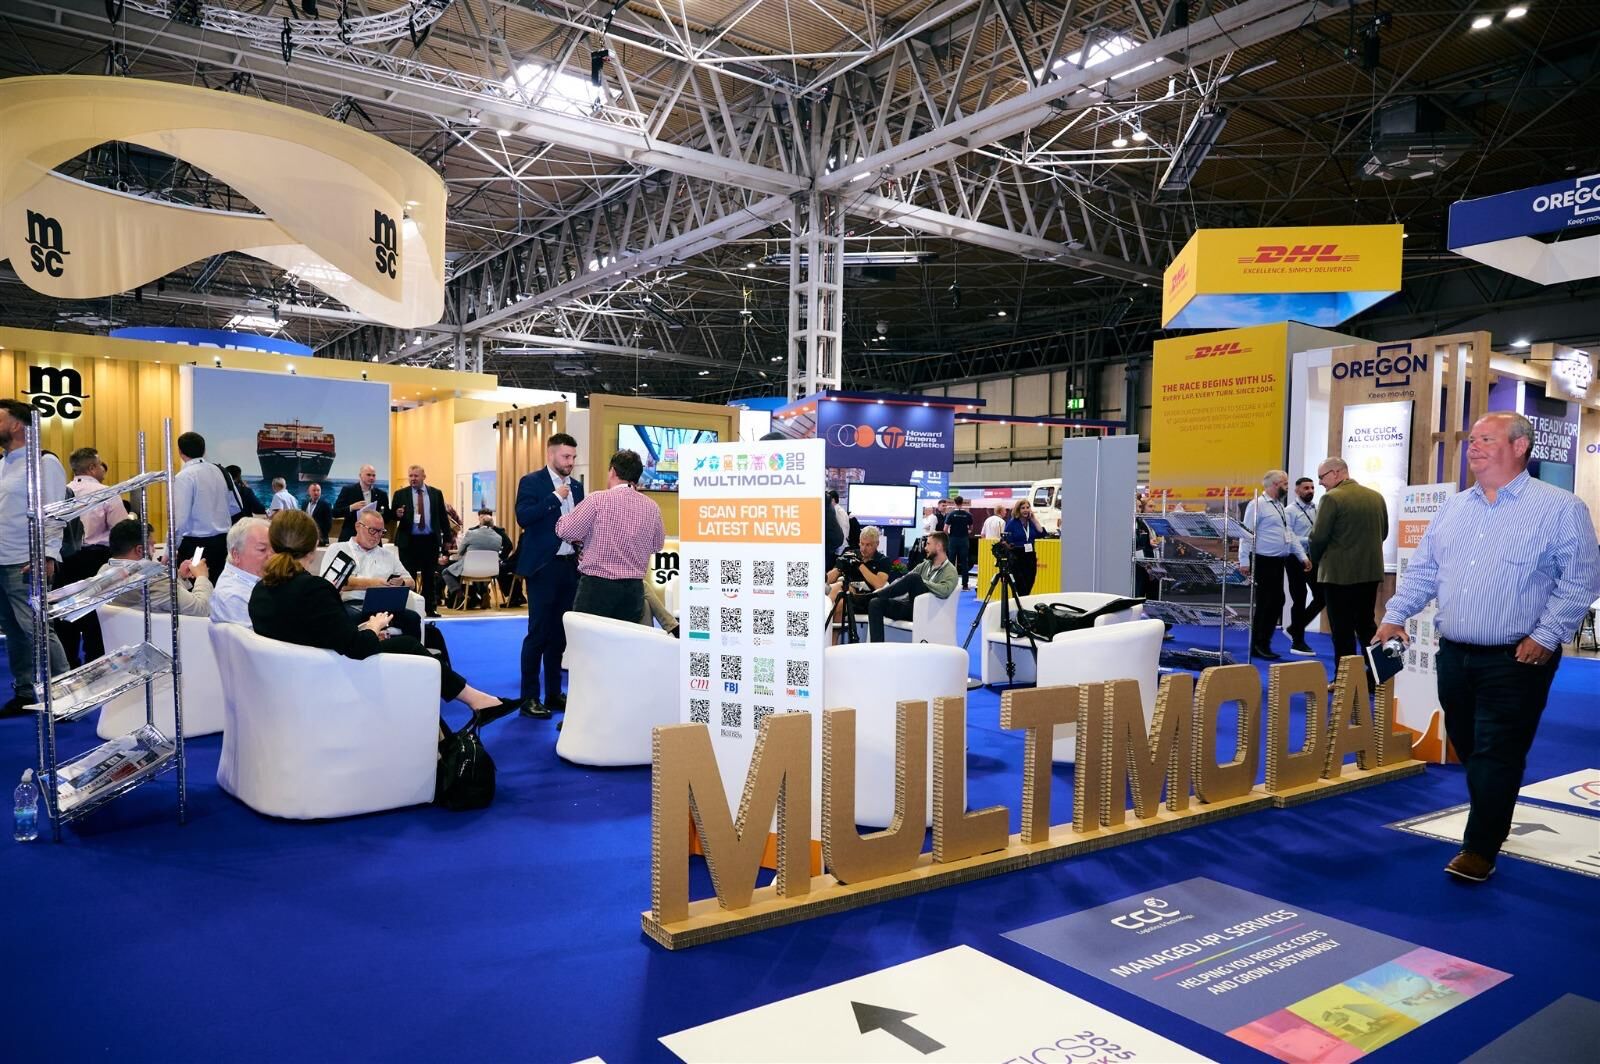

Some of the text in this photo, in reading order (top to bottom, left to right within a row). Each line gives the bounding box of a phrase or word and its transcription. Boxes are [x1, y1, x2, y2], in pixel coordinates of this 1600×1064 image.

[1567, 218, 1586, 226] Keep
[1246, 244, 1352, 264] DHL
[1243, 265, 1353, 274] EXCELLENCE. SIMPLY DELIVERED.
[1190, 342, 1247, 359] DHL
[1332, 353, 1428, 380] OREGON
[1162, 373, 1276, 393] THE RACE BEGINS WITH US.
[1162, 392, 1181, 402] EVERY
[1195, 390, 1214, 399] EVERY
[1236, 387, 1255, 396] SINCE
[1368, 392, 1387, 400] Keep
[907, 430, 942, 438] Howard
[1373, 426, 1397, 434] CLICK
[1539, 417, 1564, 433] READY
[1564, 422, 1578, 437] FOR
[905, 435, 937, 443] Tenens
[905, 441, 945, 449] Logistics
[1348, 433, 1403, 443] ALL CUSTOMS
[693, 474, 806, 487] MULTIMODAL
[699, 504, 800, 519] SCAN FOR THE
[1404, 505, 1440, 513] MULTIMOD
[698, 521, 801, 537] LATEST NEWS
[724, 681, 739, 695] FBJ
[651, 655, 1414, 925] MULTIMODAL
[1110, 909, 1298, 978] MANAGED 4PL SERVICES
[1176, 929, 1329, 990] HELPING YOU REDUCE COSTS
[1207, 938, 1342, 995] AND GROW, SUSTAINABLY
[1074, 1030, 1137, 1061] 2025
